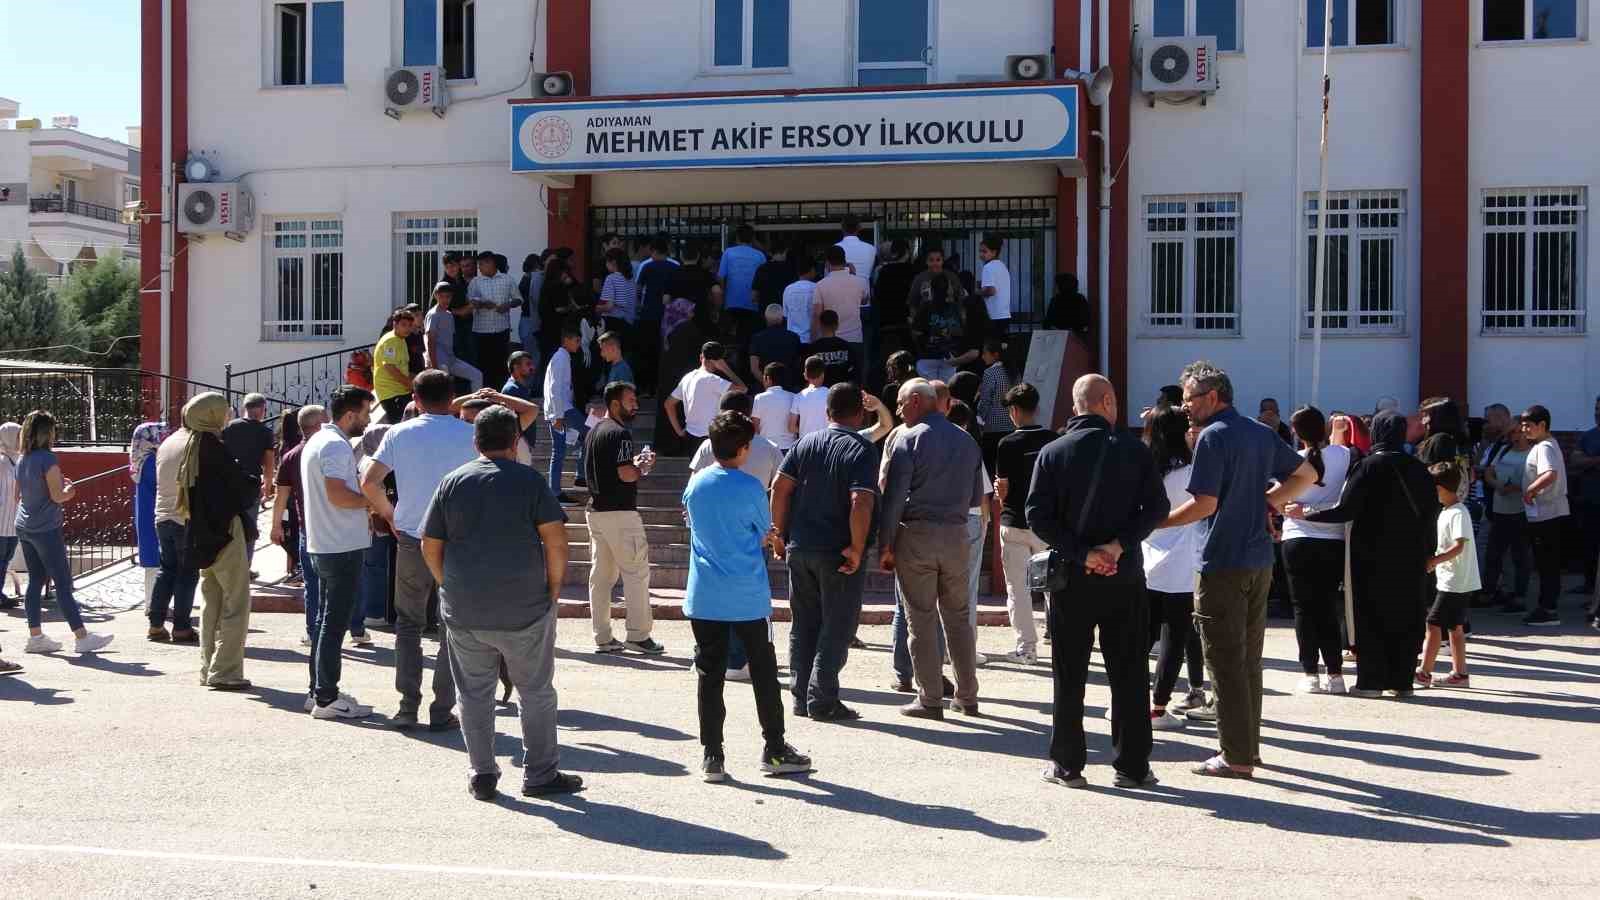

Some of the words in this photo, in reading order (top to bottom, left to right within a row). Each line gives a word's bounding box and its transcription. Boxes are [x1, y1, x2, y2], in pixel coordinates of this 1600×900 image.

[1196, 44, 1207, 83] VESTEL
[422, 71, 432, 104] VESTEL
[585, 128, 705, 154] MEHMET
[711, 121, 774, 151] AKİF
[781, 124, 872, 148] ERSOY
[880, 117, 1024, 146] İLKOKULU
[586, 115, 652, 128] ADIYAMAN
[220, 191, 229, 225] VESTEL
